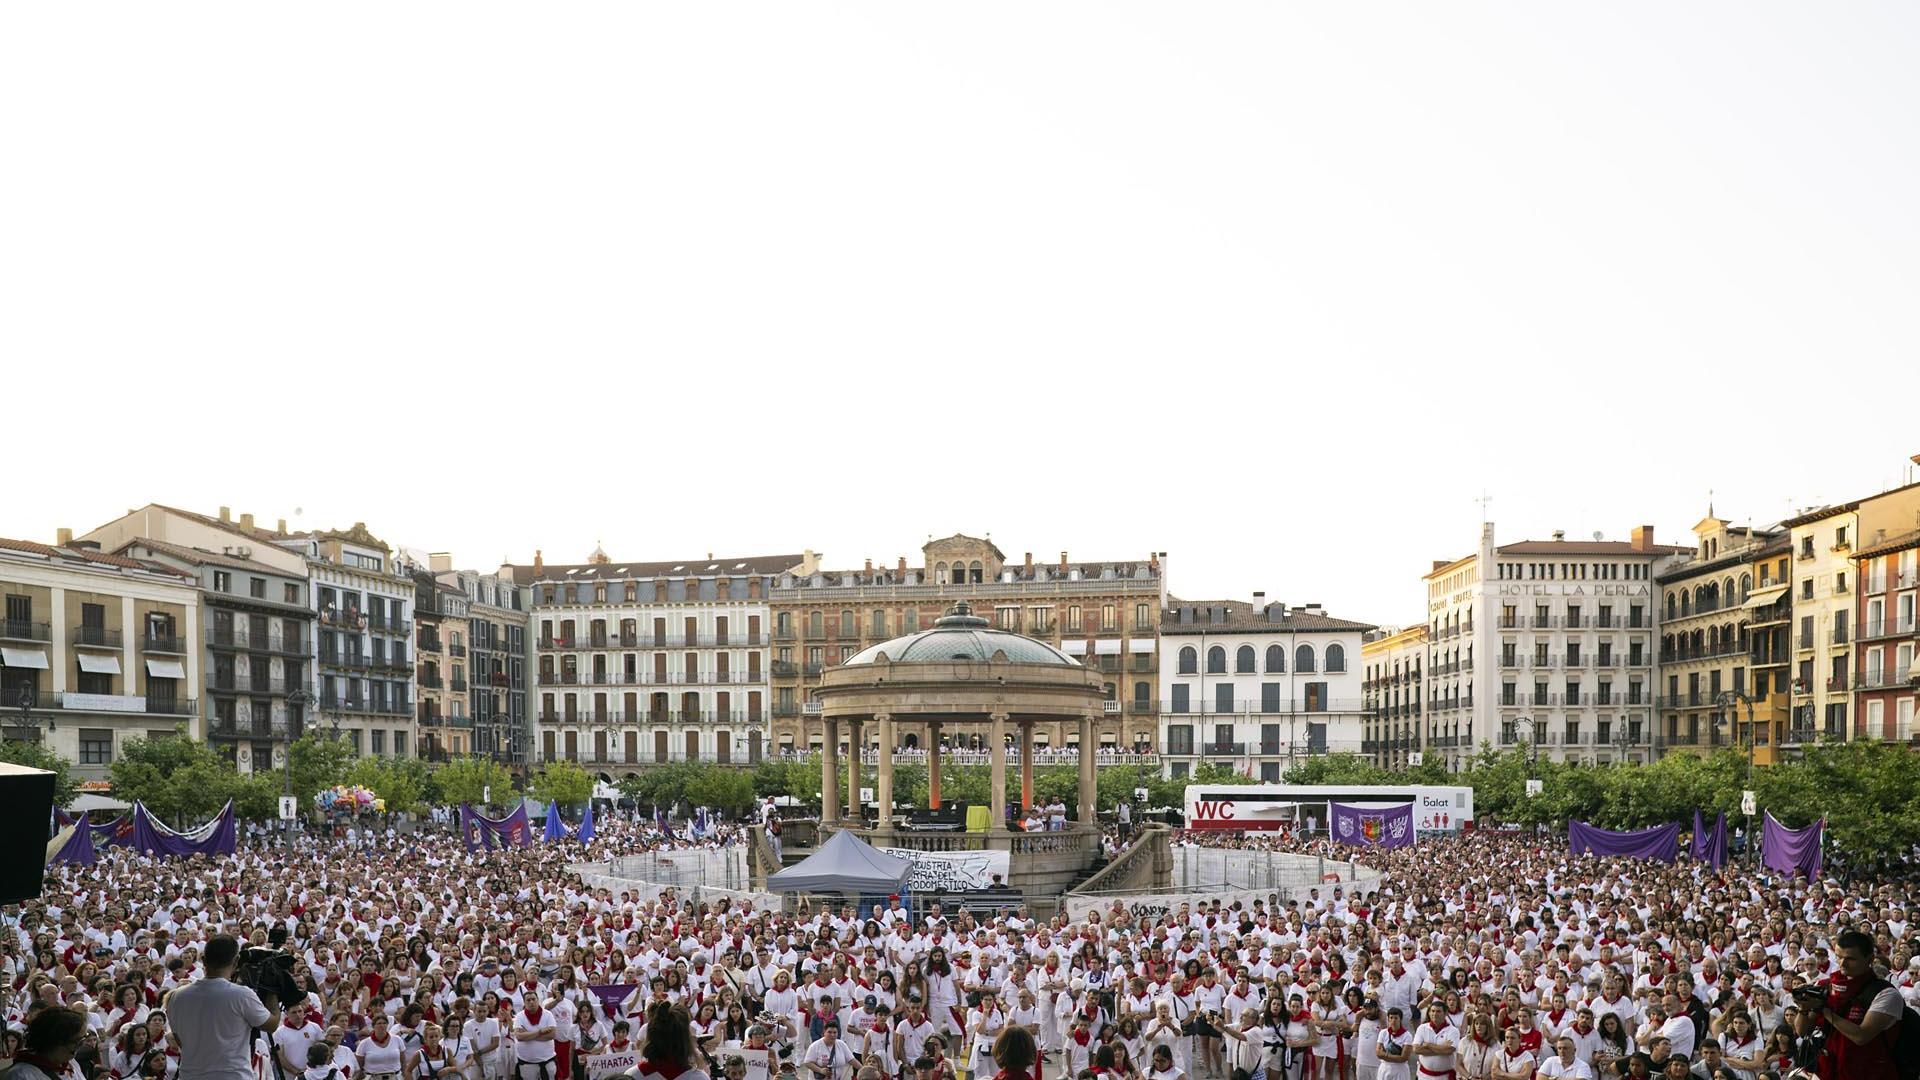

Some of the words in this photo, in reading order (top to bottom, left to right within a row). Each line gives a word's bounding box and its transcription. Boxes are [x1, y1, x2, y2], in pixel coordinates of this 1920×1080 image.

[1500, 583, 1552, 596] HOTEL
[1562, 583, 1584, 596] LA
[1594, 584, 1649, 596] PERLA
[1423, 796, 1448, 807] balat
[1195, 800, 1234, 820] WC
[912, 860, 952, 871] NDUSTRIA
[907, 879, 968, 891] RODOMESTICO
